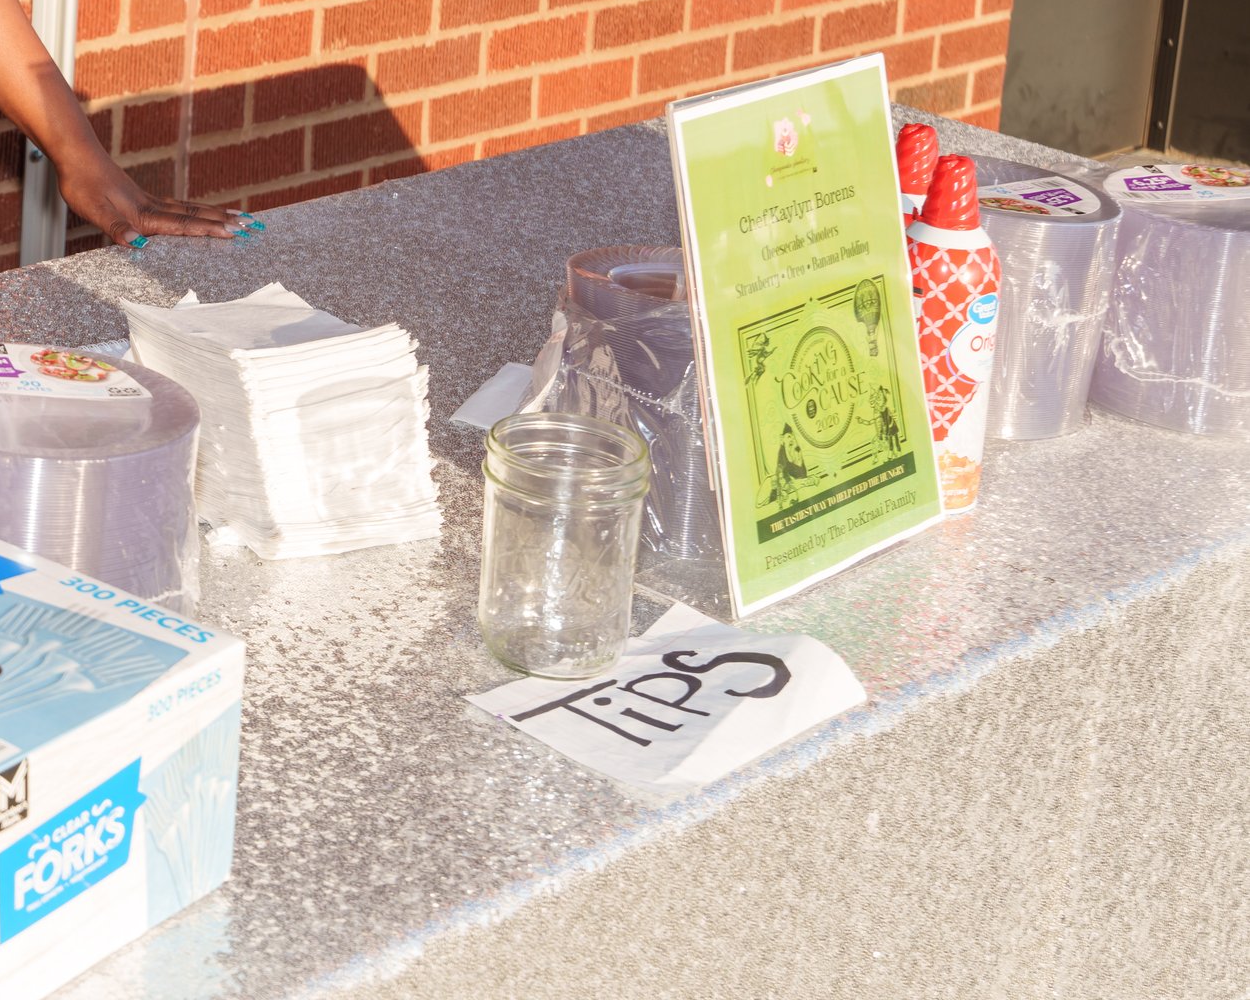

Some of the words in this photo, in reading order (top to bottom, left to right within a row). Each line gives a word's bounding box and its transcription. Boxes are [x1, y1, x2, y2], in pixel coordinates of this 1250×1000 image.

[739, 208, 768, 234] Chef
[770, 200, 813, 223] Kaylyn
[814, 185, 855, 209] Borens
[735, 273, 781, 299] Strawberry
[786, 263, 806, 280] Oreo
[812, 252, 840, 271] Banana
[840, 240, 870, 260] Pudding
[761, 235, 806, 261] Cheesecake
[806, 225, 839, 245] Shooters
[819, 371, 868, 411] CAUSE
[770, 520, 784, 533] THE
[784, 507, 814, 525] TASTIEST
[813, 502, 827, 514] WAY
[827, 498, 836, 508] TO
[836, 489, 852, 503] HELP
[852, 482, 868, 497] FEED
[867, 476, 880, 488] THE
[880, 464, 905, 482] HUNGRY
[765, 536, 814, 570] Presented
[815, 532, 827, 548] by
[827, 523, 846, 541] The
[847, 502, 884, 532] DeKraai
[884, 489, 916, 514] Family
[59, 576, 116, 600] 300
[114, 599, 215, 643] PIECES
[176, 668, 222, 705] PIECES
[52, 810, 90, 843] CLEAR
[14, 806, 126, 911] FORKS
